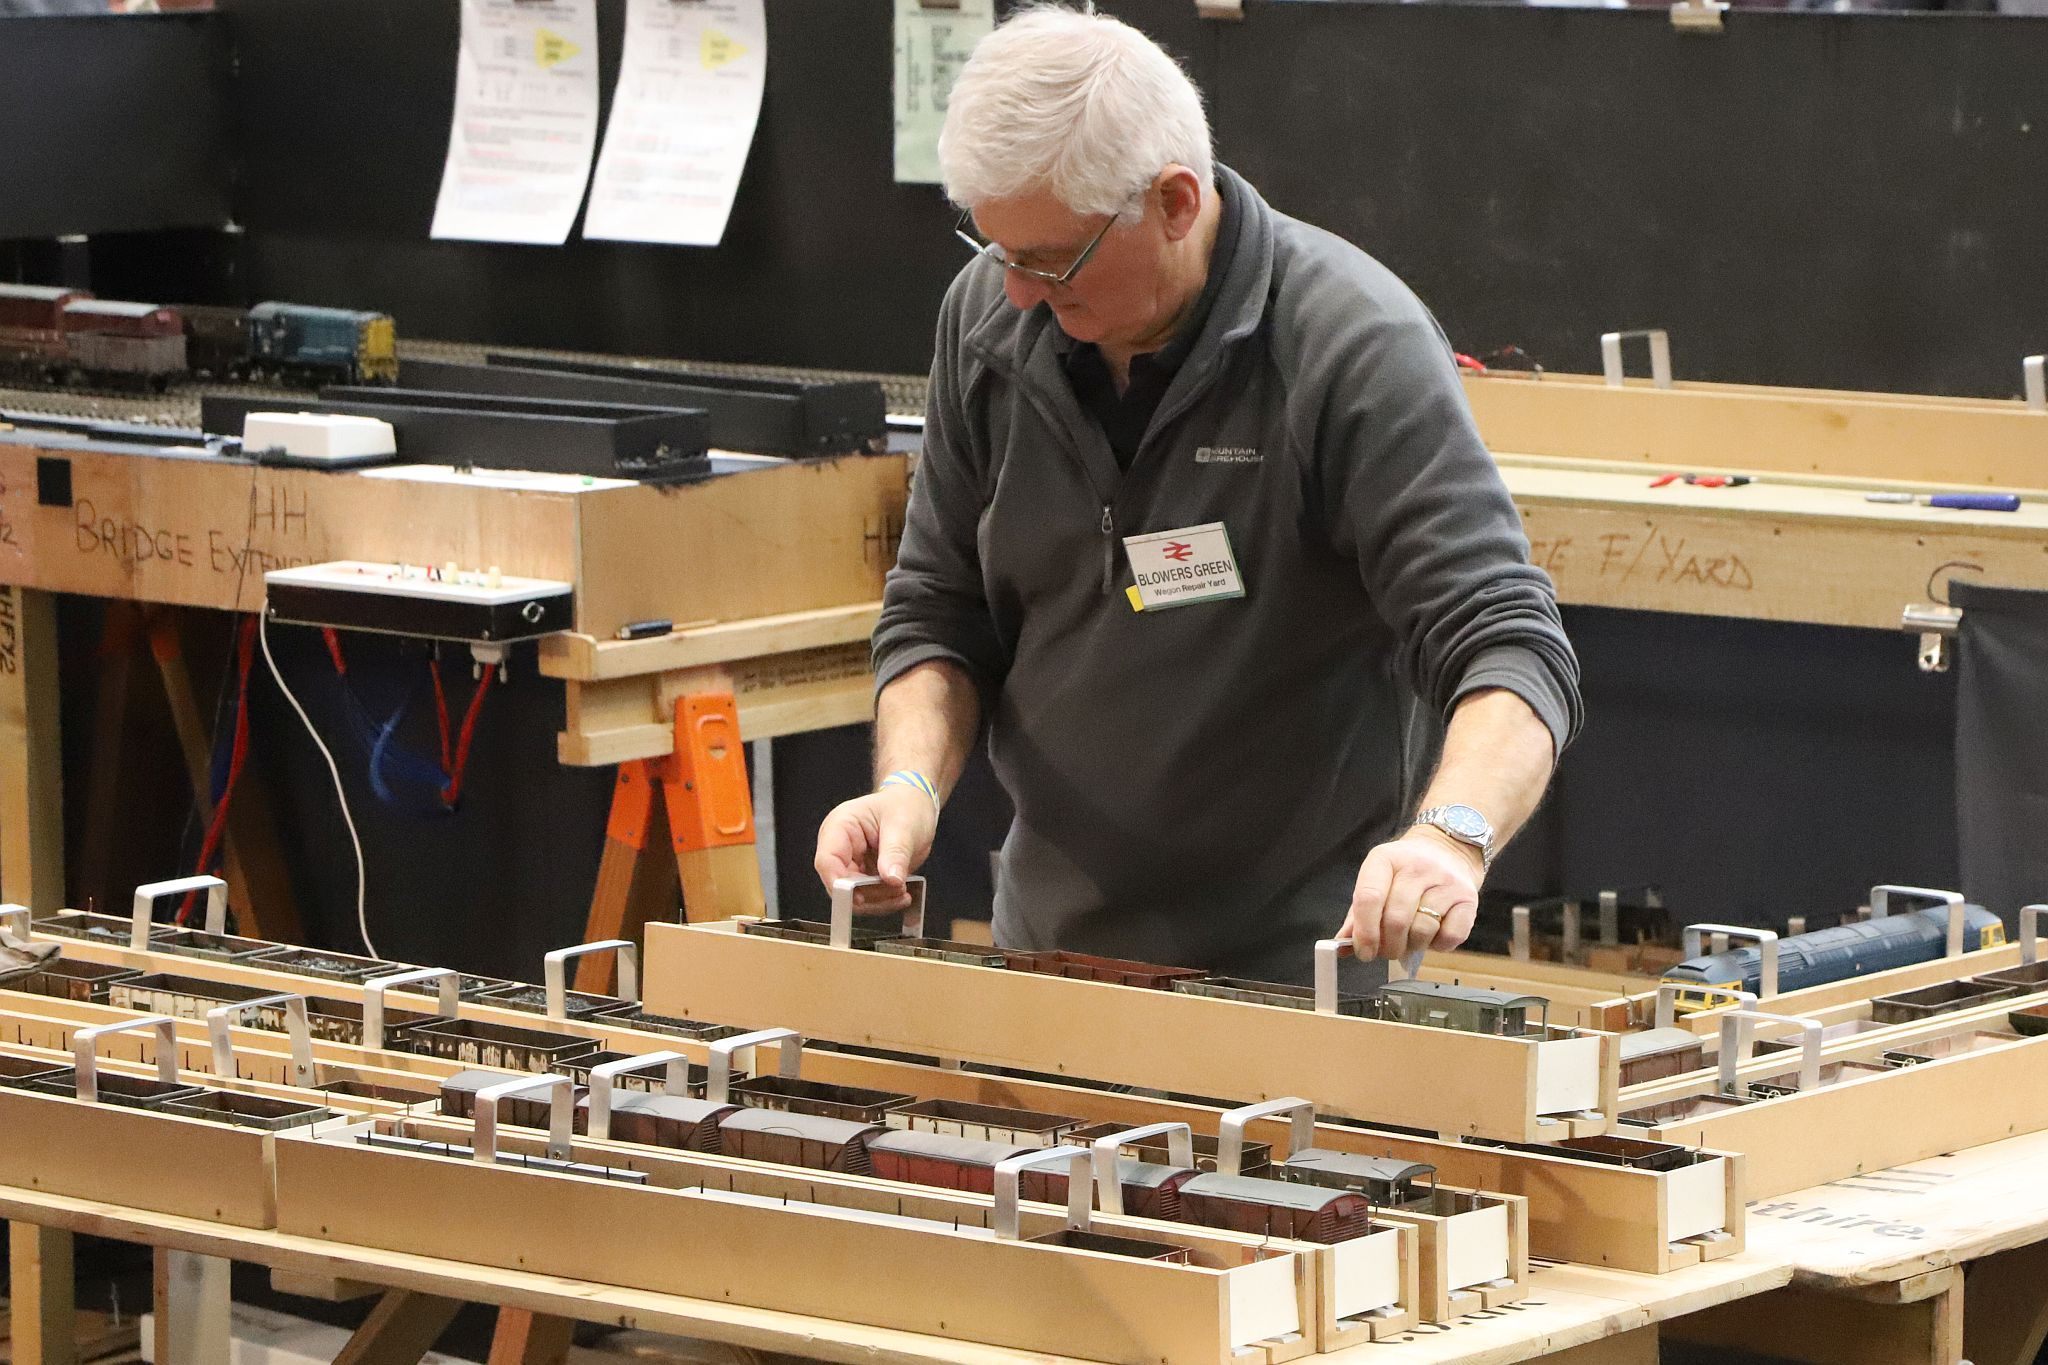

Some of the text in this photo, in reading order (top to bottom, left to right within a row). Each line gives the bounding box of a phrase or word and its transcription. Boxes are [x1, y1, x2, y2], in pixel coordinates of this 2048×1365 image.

[252, 484, 308, 537] HH
[75, 499, 194, 566] BRIDGE
[1138, 560, 1233, 587] BLOWERS GREEN
[1181, 582, 1206, 593] Repair
[1207, 578, 1226, 588] Yard
